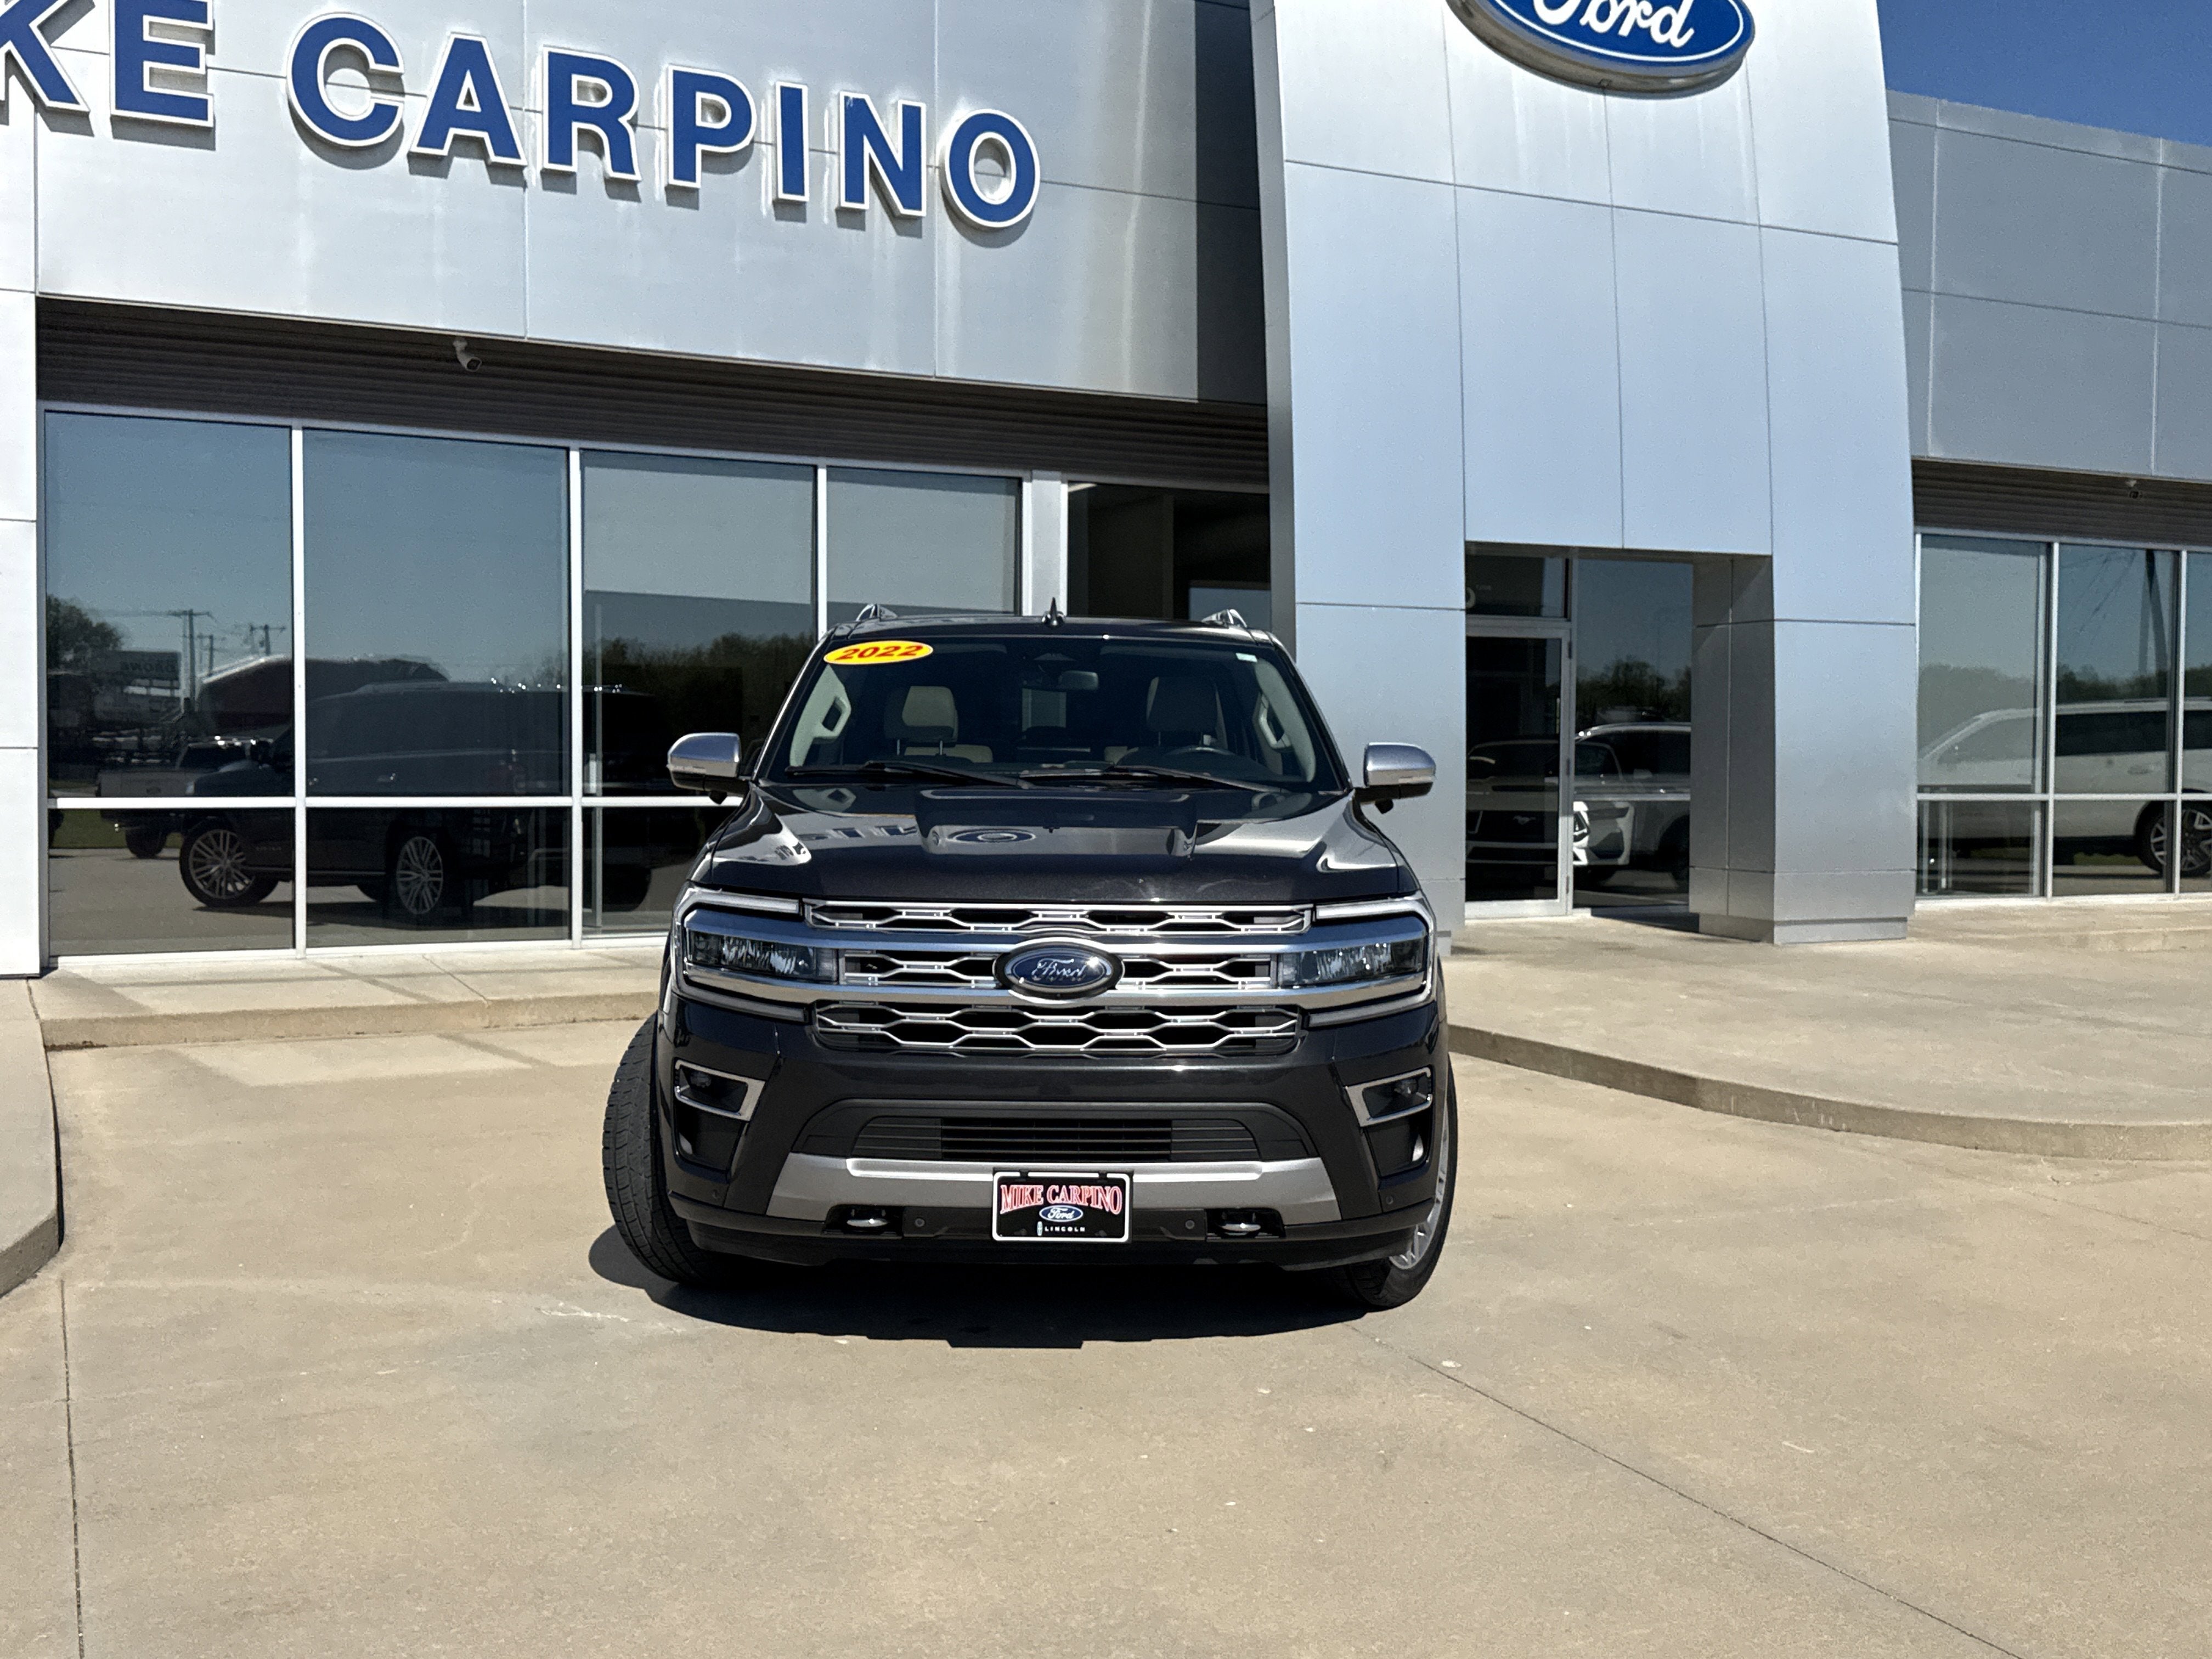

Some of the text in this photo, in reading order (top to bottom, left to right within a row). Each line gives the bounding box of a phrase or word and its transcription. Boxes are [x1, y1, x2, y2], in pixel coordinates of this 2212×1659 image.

[287, 12, 1041, 229] CARPINO
[834, 645, 923, 661] 2022
[1031, 958, 1088, 981] Ford
[1000, 1184, 1123, 1215] MIKE CARPINO
[1047, 1207, 1075, 1219] Ford
